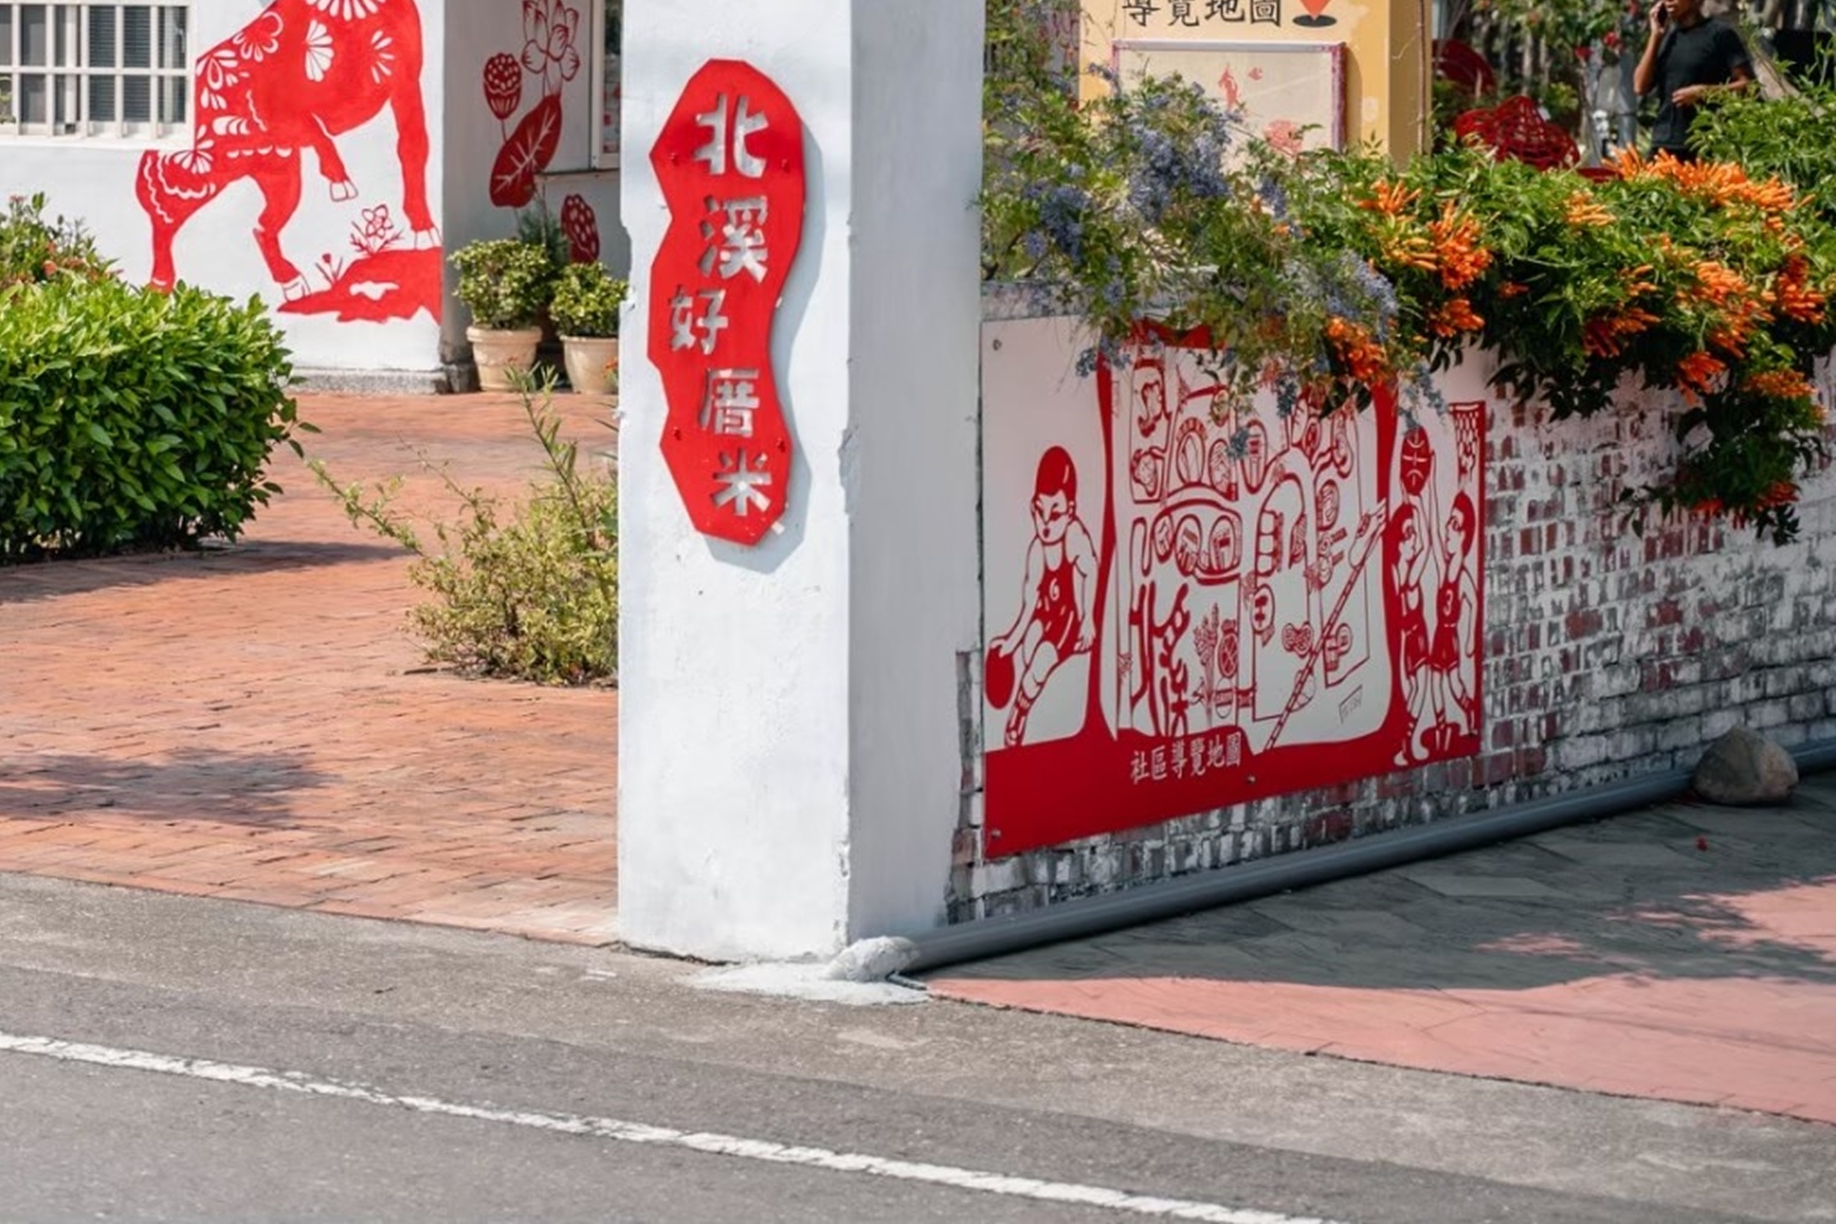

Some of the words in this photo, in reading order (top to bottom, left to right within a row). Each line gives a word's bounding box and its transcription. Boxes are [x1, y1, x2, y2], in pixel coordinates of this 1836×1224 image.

[667, 93, 773, 517] 北溪好厝米
[1049, 577, 1060, 601] 6
[1443, 589, 1454, 616] 3
[1130, 732, 1241, 784] 社區導覽地圖
